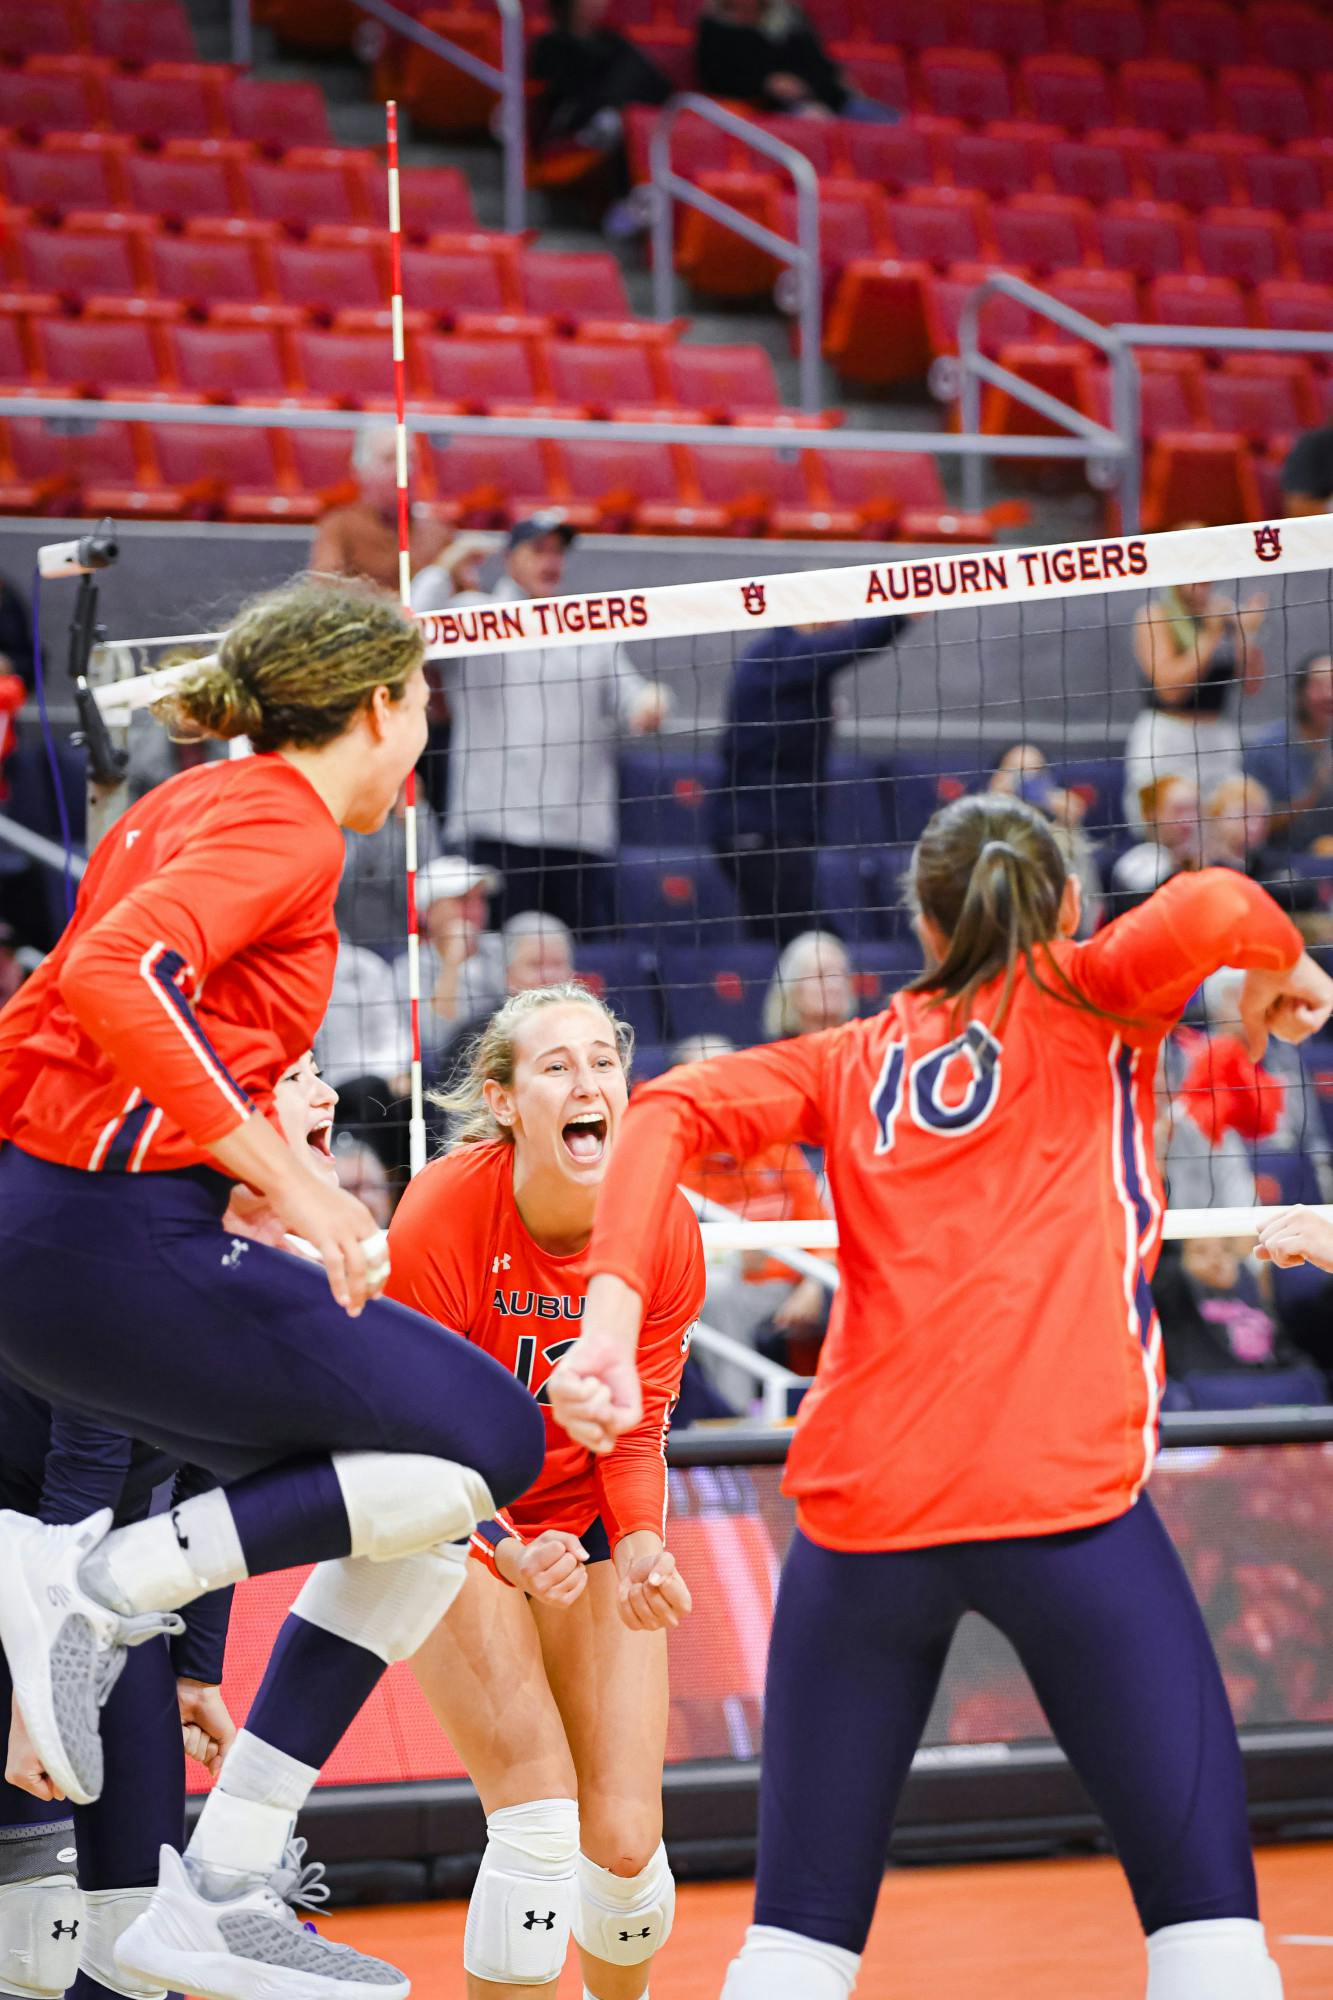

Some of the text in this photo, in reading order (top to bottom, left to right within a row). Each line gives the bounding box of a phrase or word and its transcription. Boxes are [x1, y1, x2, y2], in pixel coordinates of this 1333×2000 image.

[865, 541, 1148, 603] AUBURN TIGERS
[421, 595, 648, 645] UBURN TIGERS
[869, 1019, 1003, 1156] 10
[492, 1289, 587, 1321] AUBU
